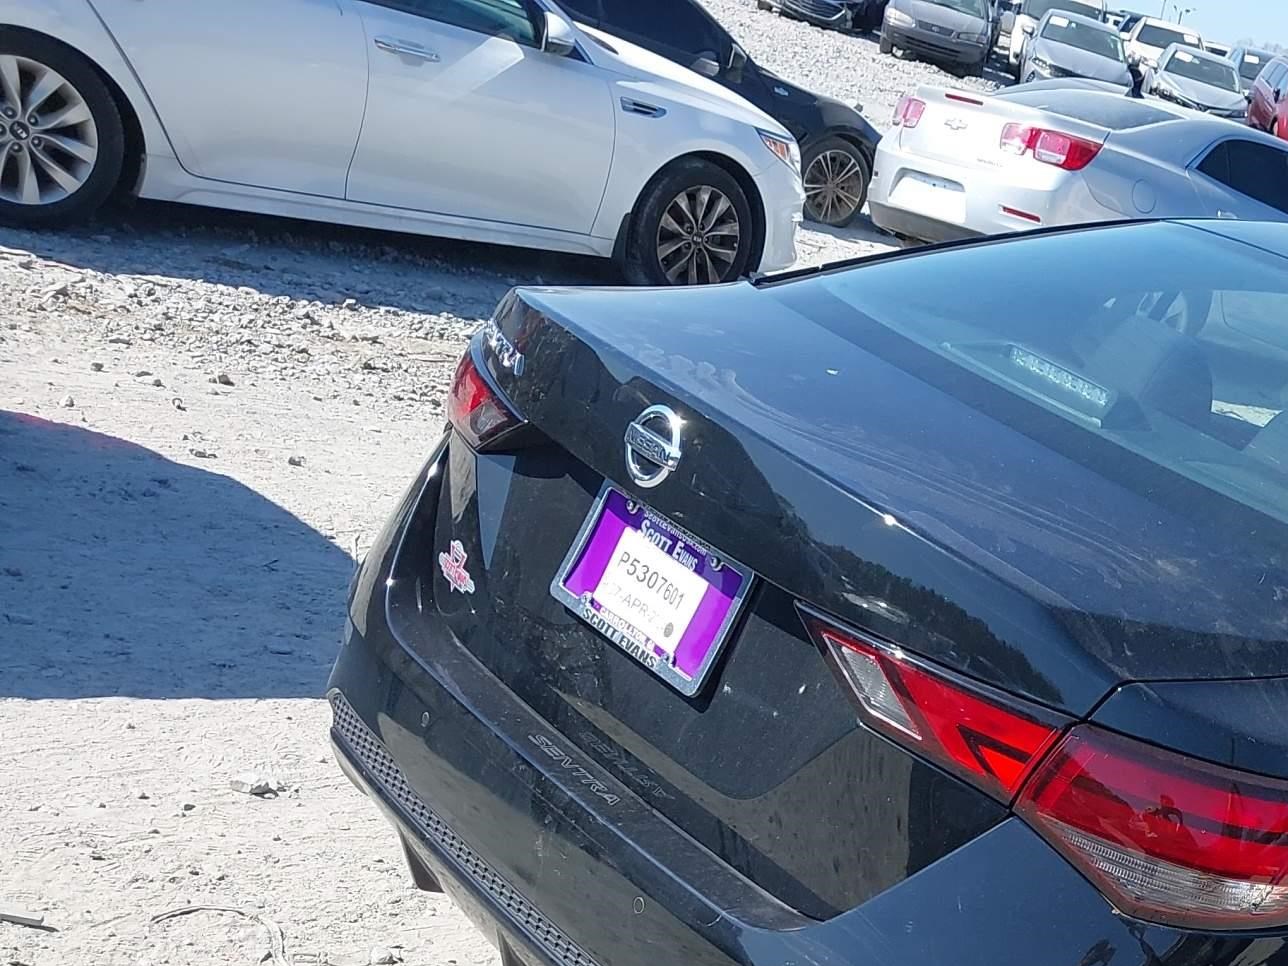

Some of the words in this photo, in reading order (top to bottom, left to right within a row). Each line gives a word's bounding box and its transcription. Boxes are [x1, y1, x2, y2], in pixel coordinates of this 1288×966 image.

[629, 427, 671, 464] NISSAN
[617, 551, 686, 610] P5307601
[583, 608, 619, 640] SCOTT
[618, 635, 657, 669] EVANS
[528, 734, 621, 807] SENTRA
